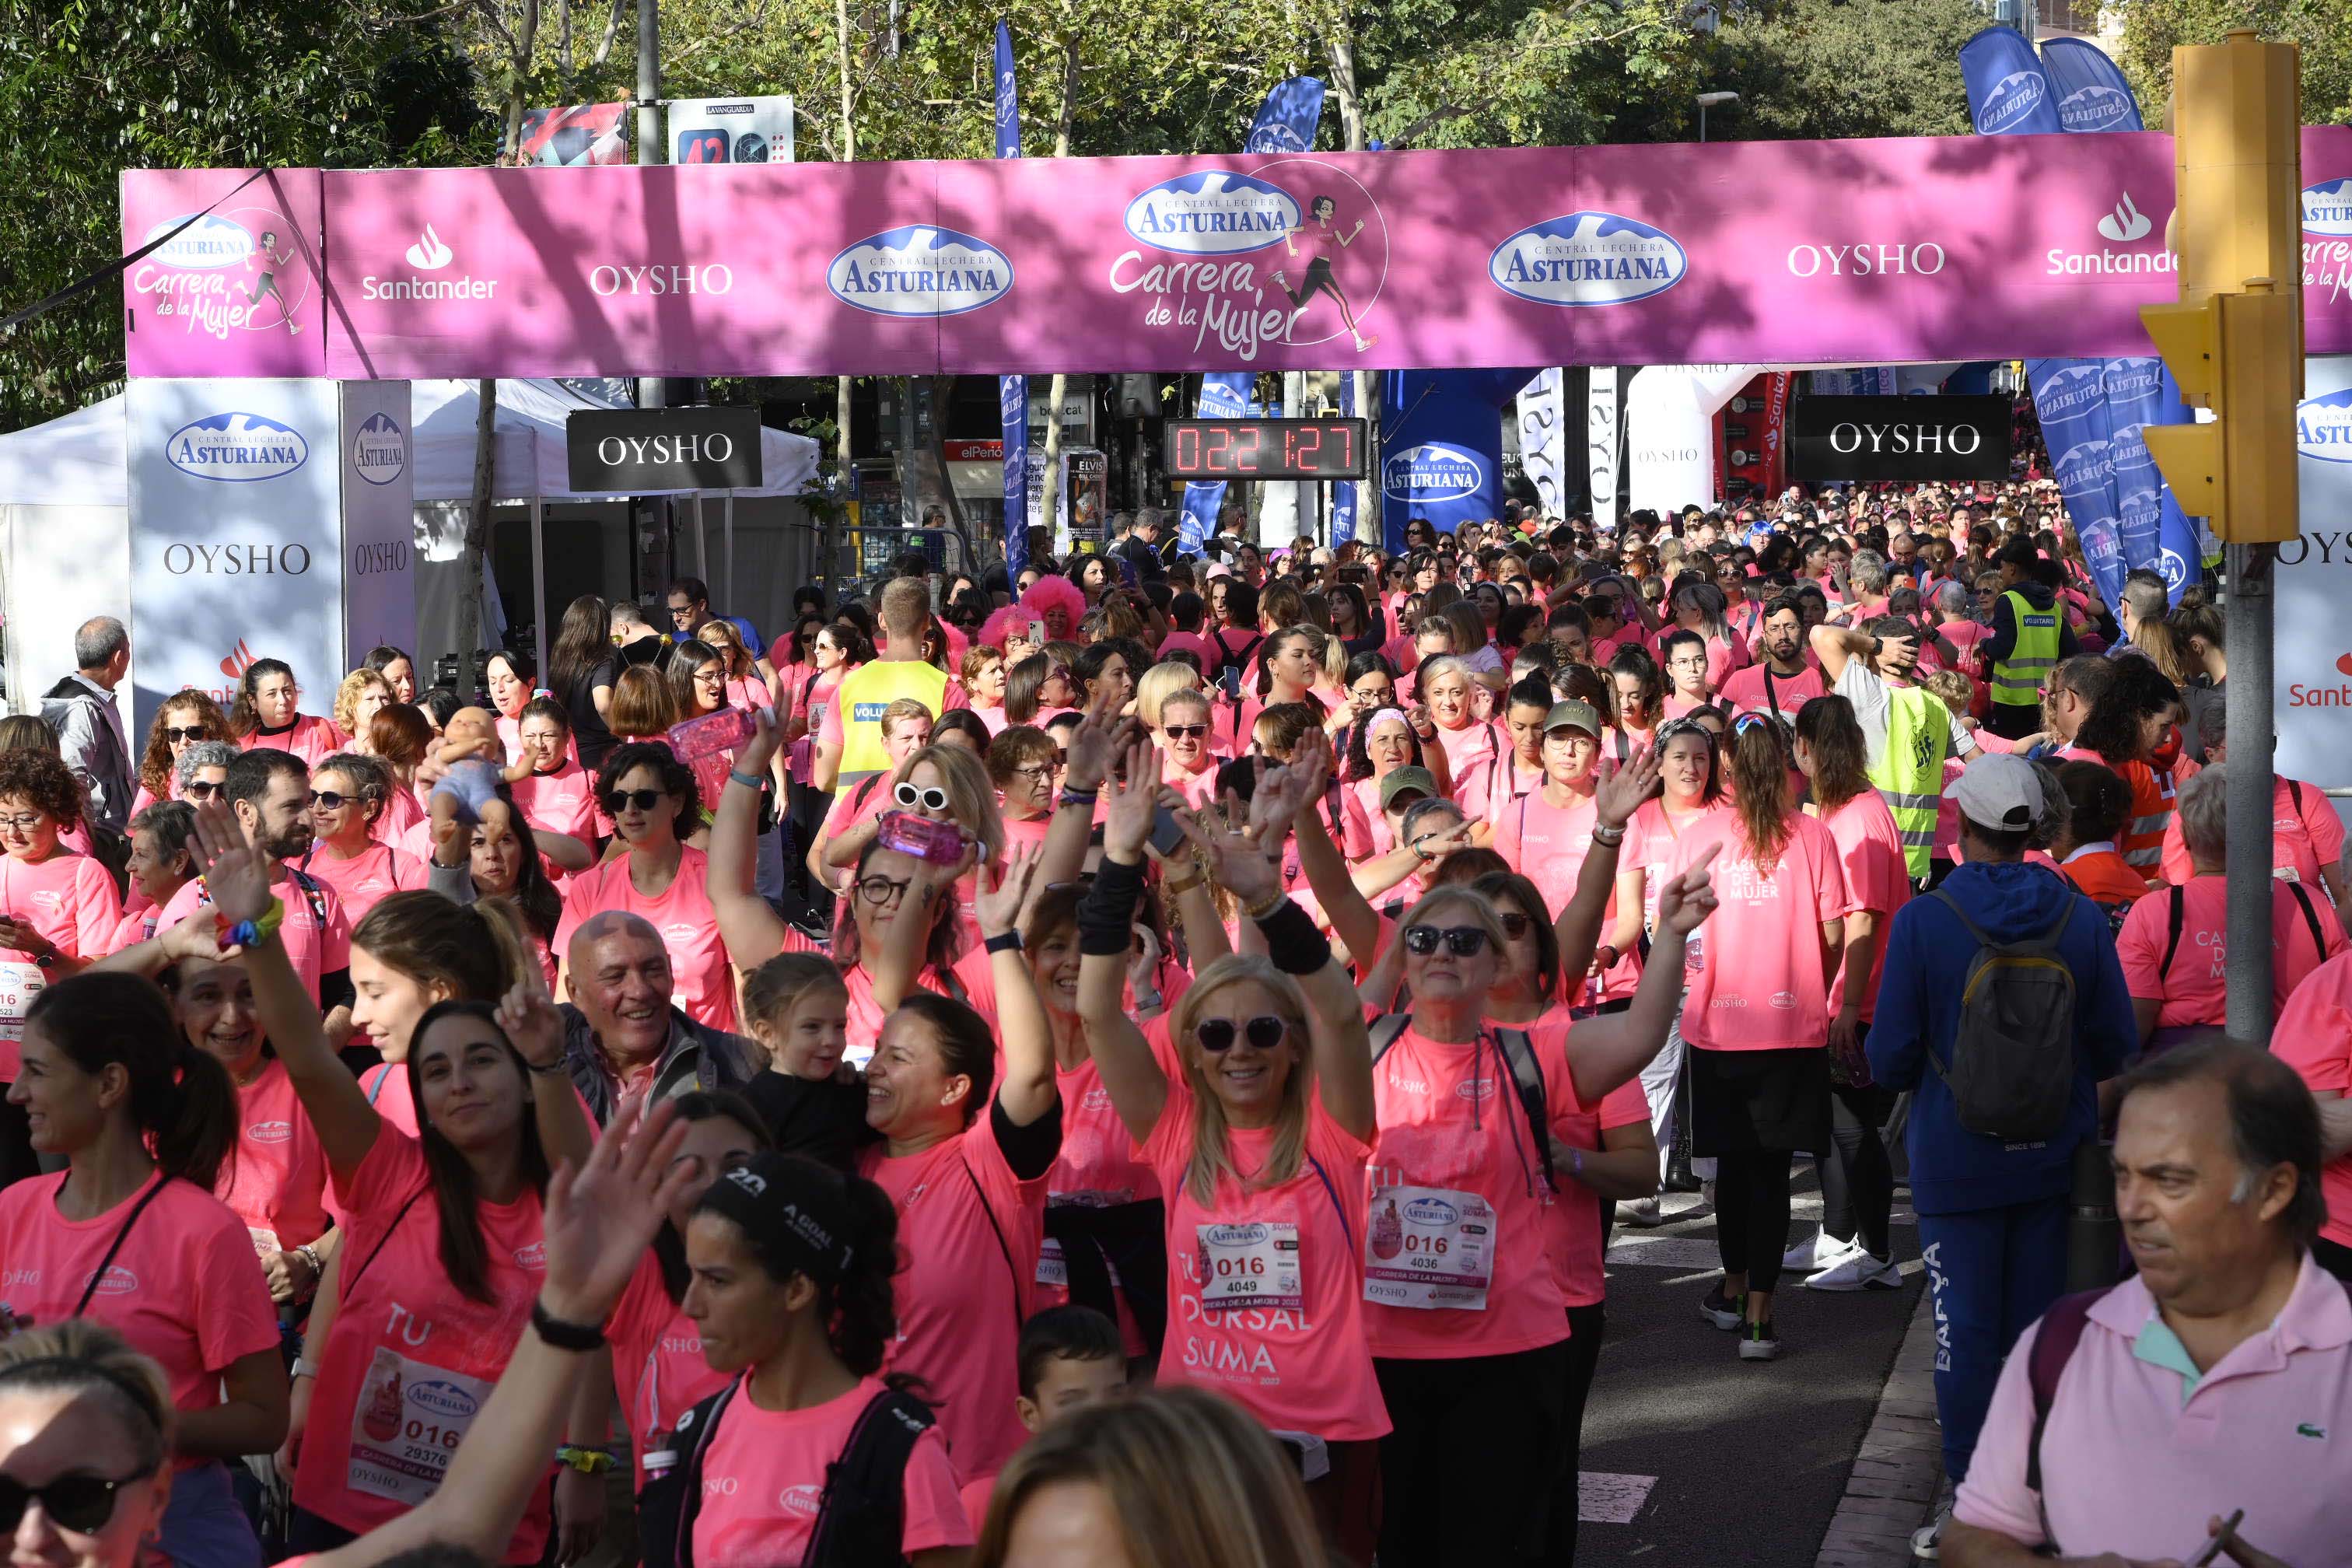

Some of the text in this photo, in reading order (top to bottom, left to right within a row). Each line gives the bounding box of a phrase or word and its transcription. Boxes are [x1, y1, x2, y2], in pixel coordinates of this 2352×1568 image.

[1165, 198, 1283, 208] CENTRAL LECHERA
[1138, 203, 1286, 234] ASTURIANA
[160, 240, 246, 255] STURIANA
[1535, 243, 1664, 254] CENTRAL LECHERA
[870, 256, 992, 266] CENTRAL LECHERA
[1504, 248, 1671, 282] ASTURIANA
[1787, 242, 1945, 278] OYSHO
[134, 264, 226, 294] Carrera
[590, 263, 733, 296] OYSHO
[842, 260, 999, 293] ASTURIANA
[1109, 250, 1255, 294] Carrera
[362, 275, 498, 300] Santander
[2319, 262, 2333, 285] la
[2329, 262, 2352, 306] M
[156, 292, 261, 340] de la Mujer
[1145, 289, 1309, 361] de la Mujer
[597, 432, 733, 466] OYSHO
[1829, 422, 1981, 455] OYSHO
[177, 438, 298, 464] ASTURIANA
[358, 439, 403, 467] ASTURIANA
[1638, 448, 1698, 462] OYSHO
[1079, 461, 1103, 470] ELVIS
[1386, 469, 1475, 490] ASTURIANA
[163, 544, 311, 576] OYSHO
[355, 541, 407, 576] OYSHO
[856, 708, 885, 717] VOLU
[1731, 873, 1775, 885] DE LA
[1731, 885, 1779, 899] MUJER
[1712, 999, 1748, 1009] OYSHO
[2004, 1143, 2028, 1152] SINCE
[1406, 1207, 1455, 1220] ASTURIANA
[1463, 1209, 1486, 1219] SUMA
[1405, 1234, 1448, 1254] 016
[1216, 1256, 1265, 1276] 016
[1410, 1258, 1438, 1269] 4036
[1227, 1281, 1258, 1293] 4049
[1376, 1270, 1407, 1280] CARRERA
[1409, 1272, 1419, 1281] DE
[1432, 1274, 1458, 1283] MUJER
[1370, 1285, 1407, 1298] OYSHO
[386, 1302, 432, 1346] TU
[1183, 1336, 1276, 1374] SUMA
[414, 1388, 472, 1413] ASTURIANA
[405, 1419, 460, 1450] 016
[404, 1445, 447, 1467] 29376
[352, 1467, 399, 1489] OYSHO
